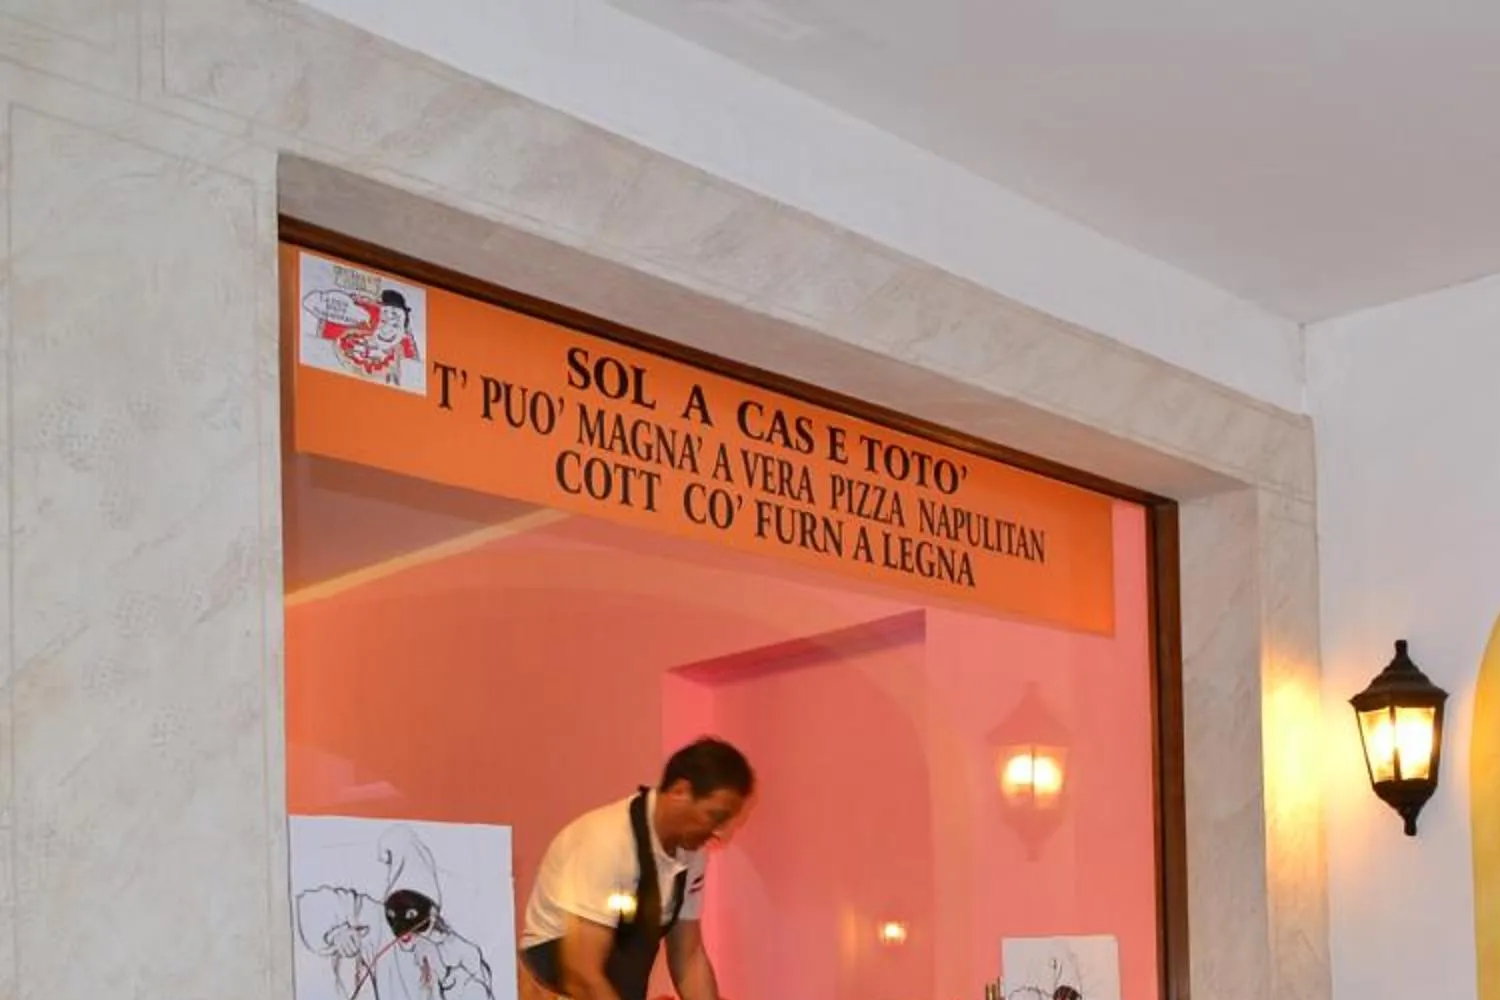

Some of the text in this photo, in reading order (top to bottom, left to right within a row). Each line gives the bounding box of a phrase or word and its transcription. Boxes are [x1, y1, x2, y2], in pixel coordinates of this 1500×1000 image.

[433, 361, 1046, 564] T' PUO' MAGNA' A VERA PIZZA NAPULITAN
[567, 347, 967, 495] SOL A CAS E TOTO'
[555, 450, 976, 588] COTT CO' FURN A LEGNA
